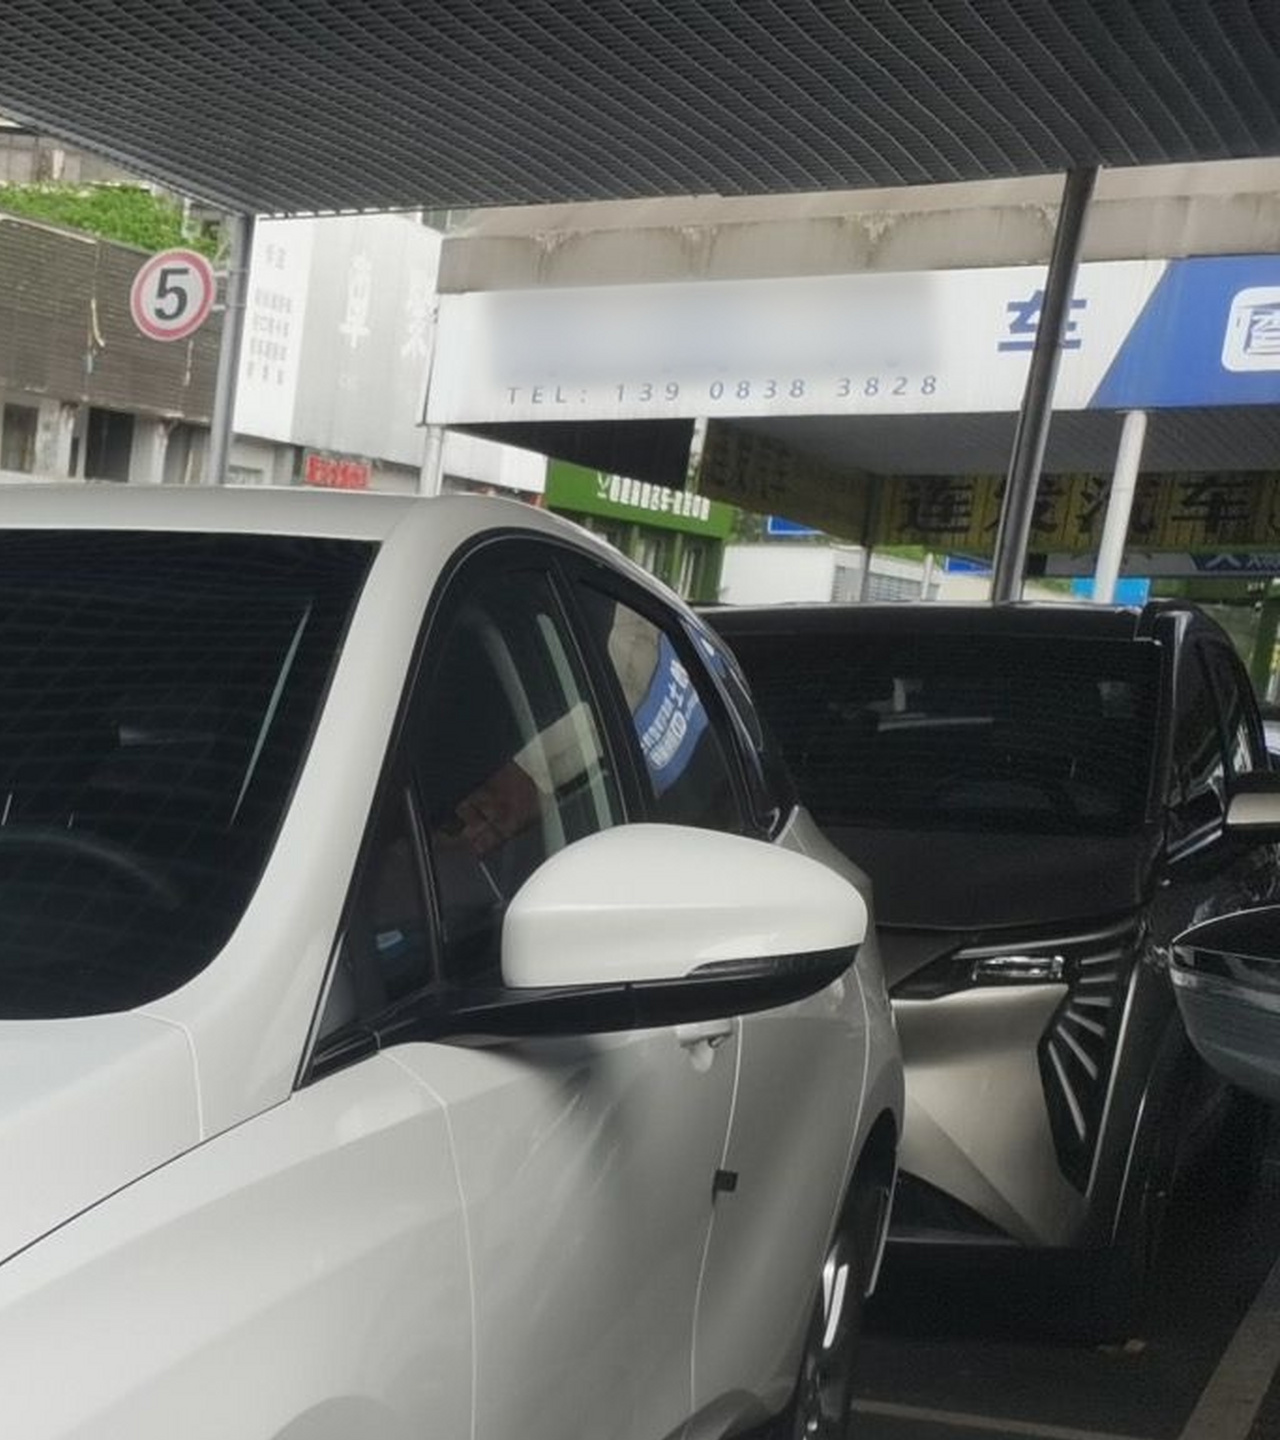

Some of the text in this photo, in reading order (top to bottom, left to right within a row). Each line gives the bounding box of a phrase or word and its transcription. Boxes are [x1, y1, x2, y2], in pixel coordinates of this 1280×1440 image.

[154, 267, 189, 321] 5
[507, 374, 938, 405] TEL: 139 0838 3828
[897, 474, 1280, 534] 连发汽车
